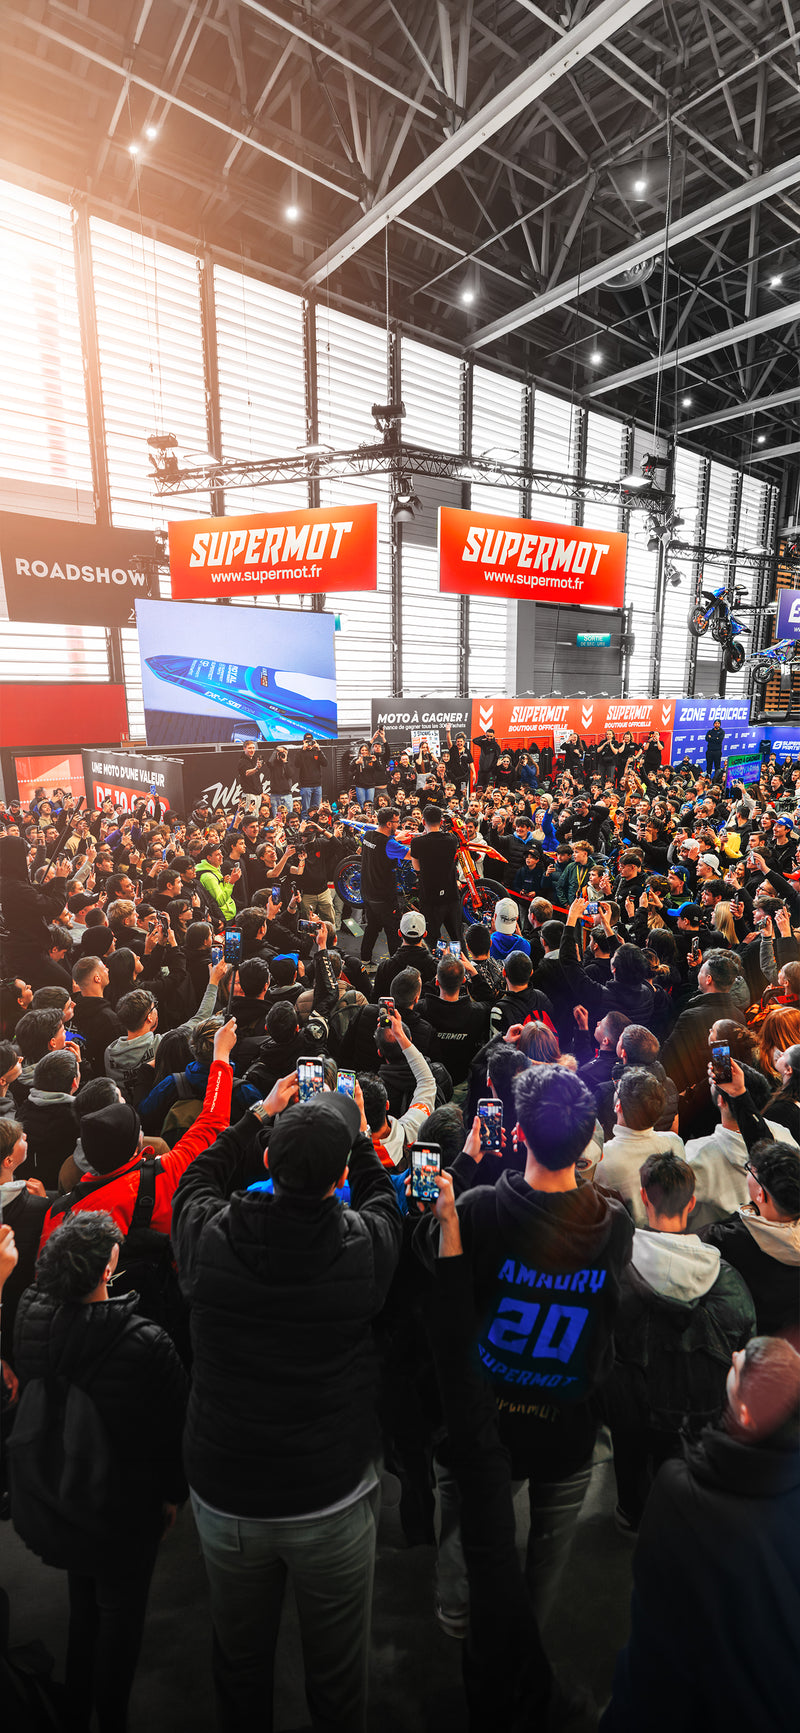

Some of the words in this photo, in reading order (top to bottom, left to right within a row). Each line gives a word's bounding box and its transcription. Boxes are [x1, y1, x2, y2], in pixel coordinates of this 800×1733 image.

[189, 521, 354, 567] SUPERMOT
[461, 526, 610, 576] SUPERMOT
[15, 557, 145, 586] ROADSHOW
[211, 564, 323, 584] www.supermot.fr
[483, 570, 584, 590] www.supermot.fr
[377, 713, 411, 724] MOTO
[411, 710, 419, 723] À
[421, 712, 463, 722] GAGNER
[510, 705, 570, 723] SUPERMOT
[606, 705, 654, 720] SUPERMOT
[679, 707, 706, 721] ZONE
[708, 705, 748, 721] DÉDICACE
[508, 724, 538, 732] BOUTIQUE
[538, 723, 568, 731] OFFICIELLE
[604, 721, 628, 729] BOUTIQUE
[91, 761, 103, 774] UNE
[103, 763, 120, 778] MOTO
[120, 766, 139, 781] D'UNE
[139, 769, 165, 788] VALEUR
[497, 1258, 607, 1293] AMAURY
[487, 1297, 590, 1364] 20
[478, 1343, 579, 1387] SUPERMOT
